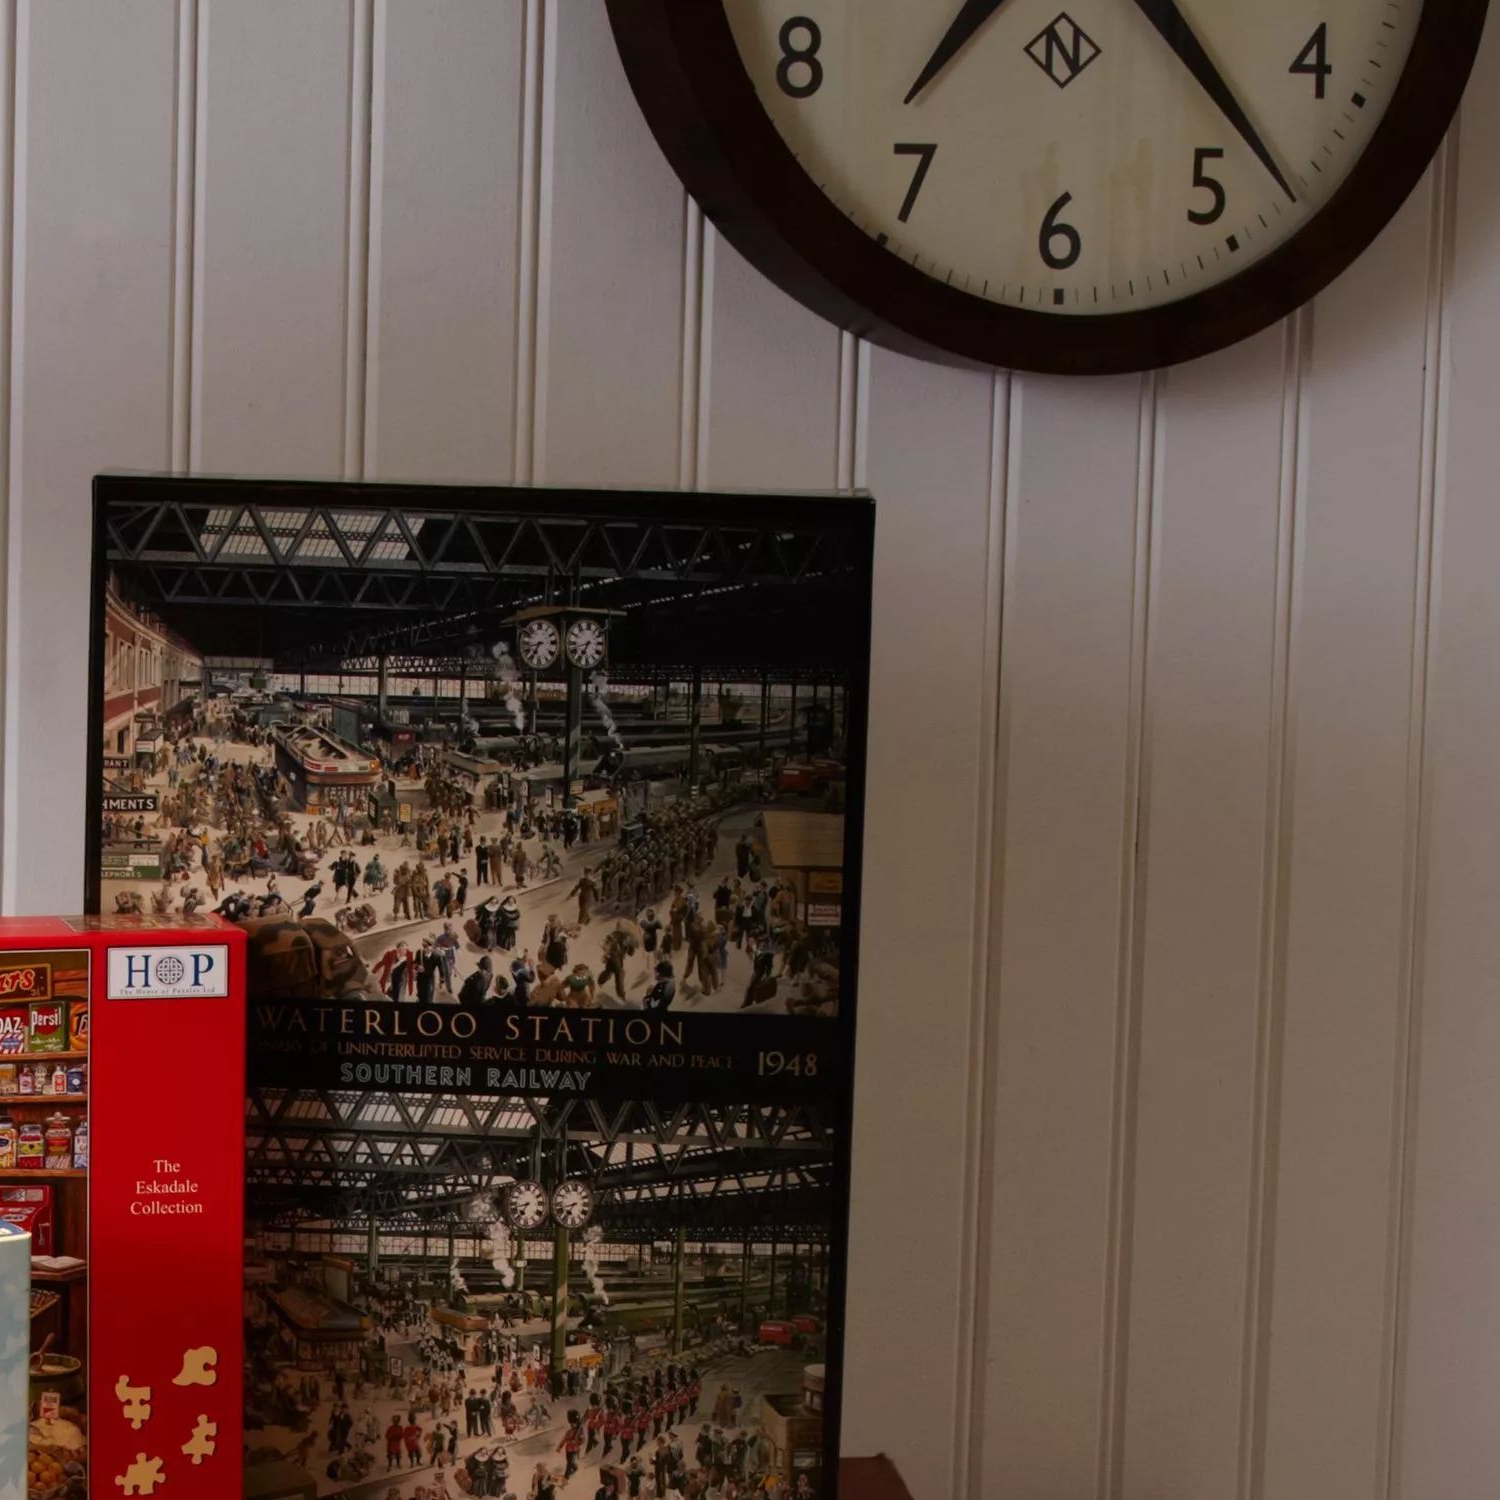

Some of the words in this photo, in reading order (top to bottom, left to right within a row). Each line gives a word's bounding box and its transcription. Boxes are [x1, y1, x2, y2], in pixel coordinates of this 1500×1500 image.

[775, 16, 824, 98] 8
[1288, 22, 1332, 99] 4
[893, 143, 938, 223] 7
[1187, 148, 1226, 225] 5
[1038, 191, 1081, 270] 6
[30, 1006, 62, 1036] Persil
[256, 1005, 477, 1038] WATERLOO
[505, 1014, 684, 1046] STATION
[337, 1041, 462, 1060] UNINTERRUPTED
[470, 1045, 527, 1061] SERVICE
[535, 1048, 596, 1064] DURING
[607, 1052, 641, 1066] WAR
[647, 1054, 685, 1068] AND
[691, 1054, 735, 1069] PEACE
[757, 1050, 818, 1077] 1948
[340, 1062, 471, 1087] SOUTHERN
[487, 1067, 592, 1091] RAILWAY
[153, 1159, 181, 1173] The
[136, 1179, 199, 1195] Eskadale
[130, 1200, 203, 1215] Collection
